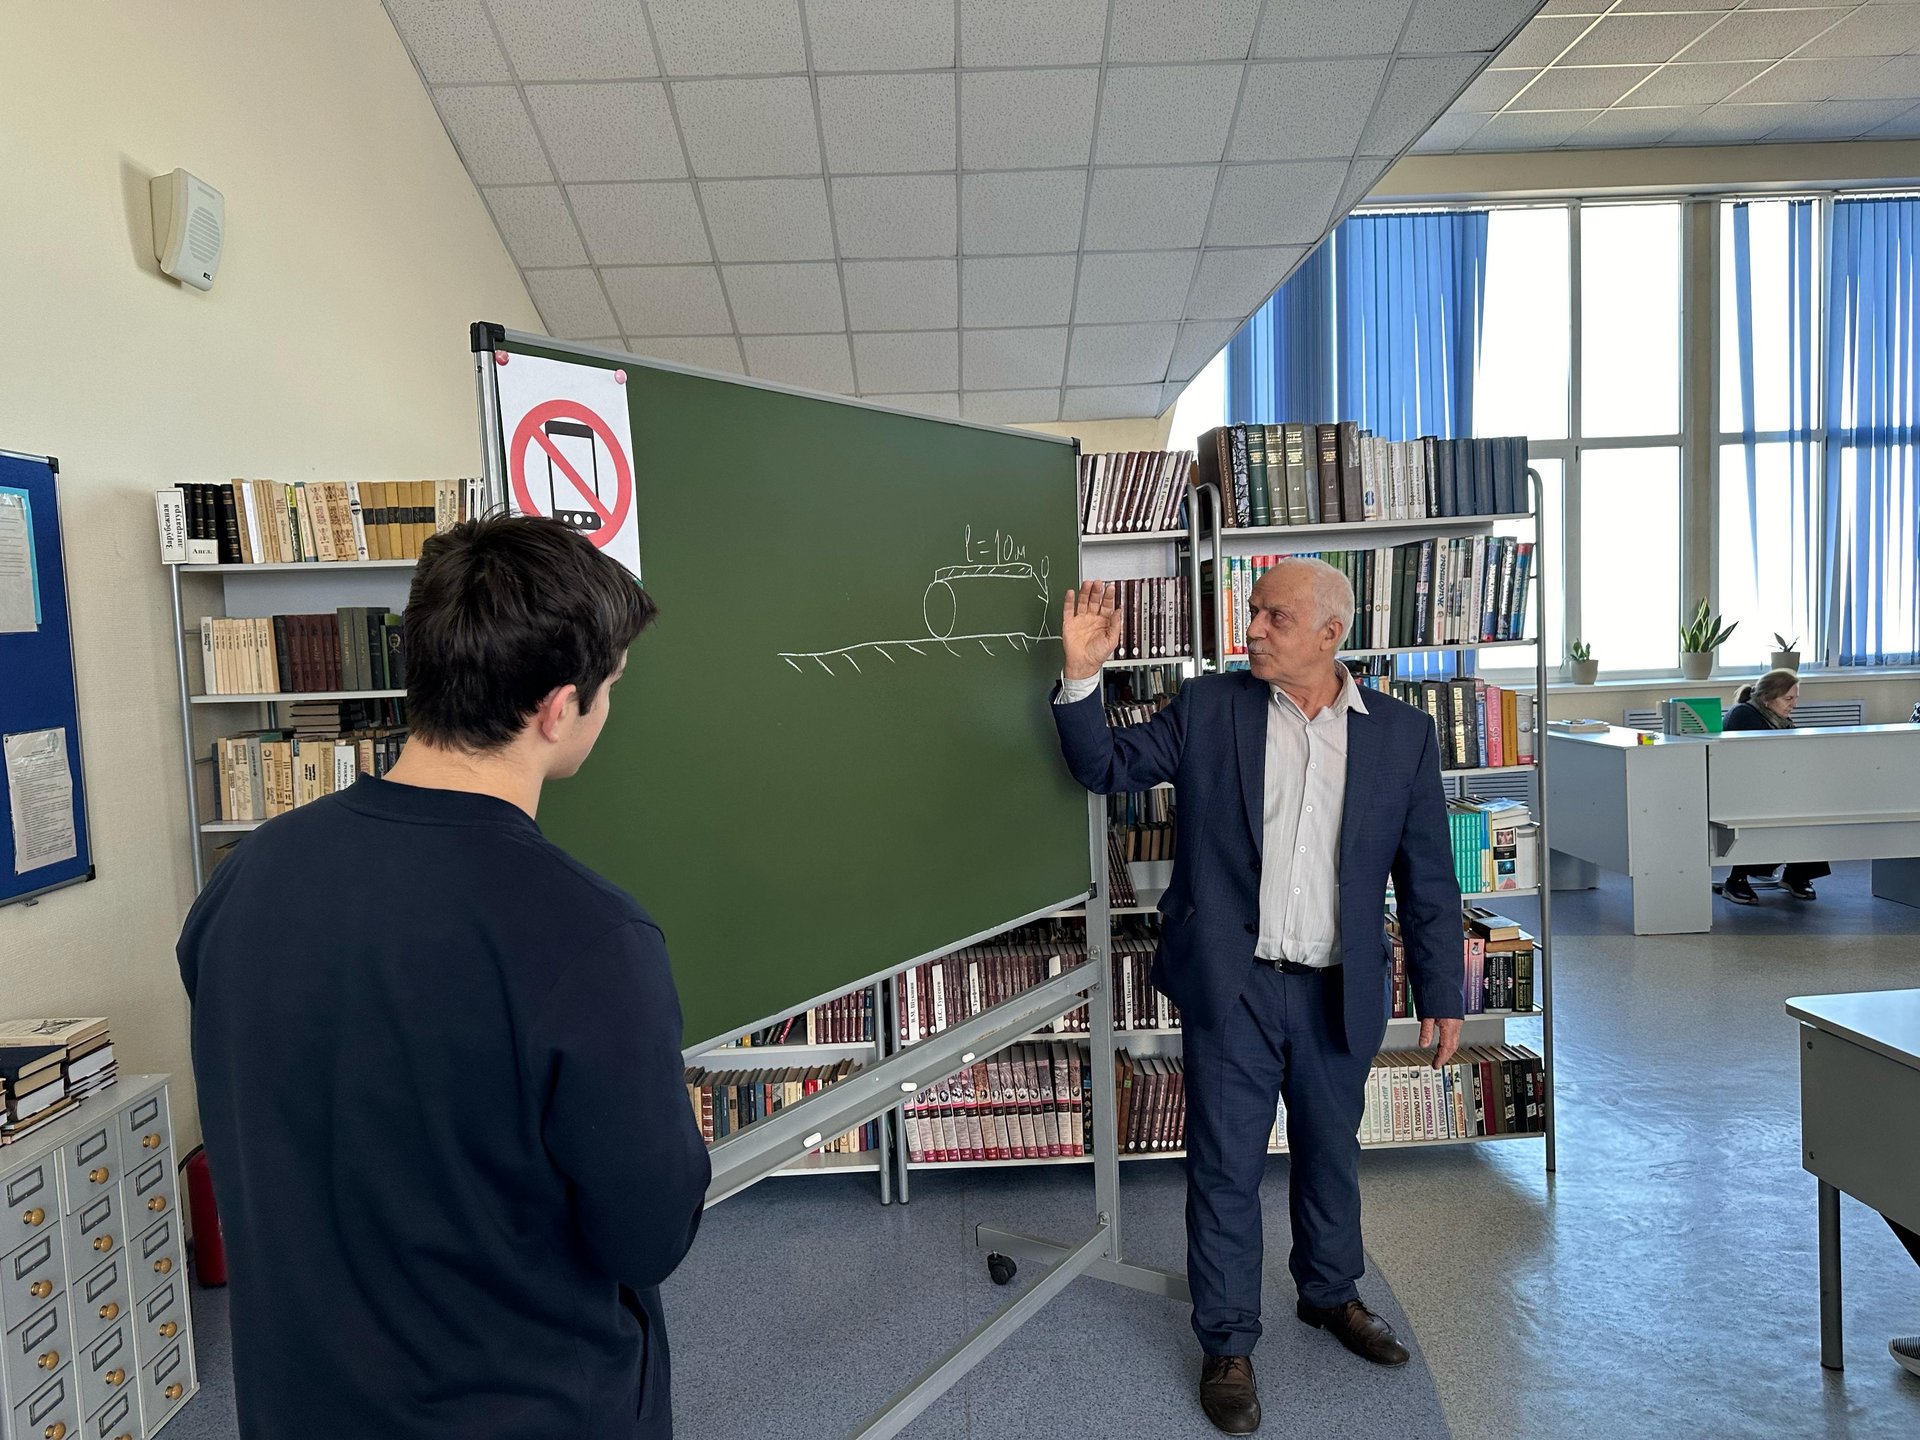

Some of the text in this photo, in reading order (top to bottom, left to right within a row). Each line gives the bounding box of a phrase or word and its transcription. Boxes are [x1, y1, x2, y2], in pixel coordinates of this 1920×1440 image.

[164, 504, 173, 549] Зарубежная
[174, 504, 183, 548] литература
[1437, 553, 1446, 608] Животные
